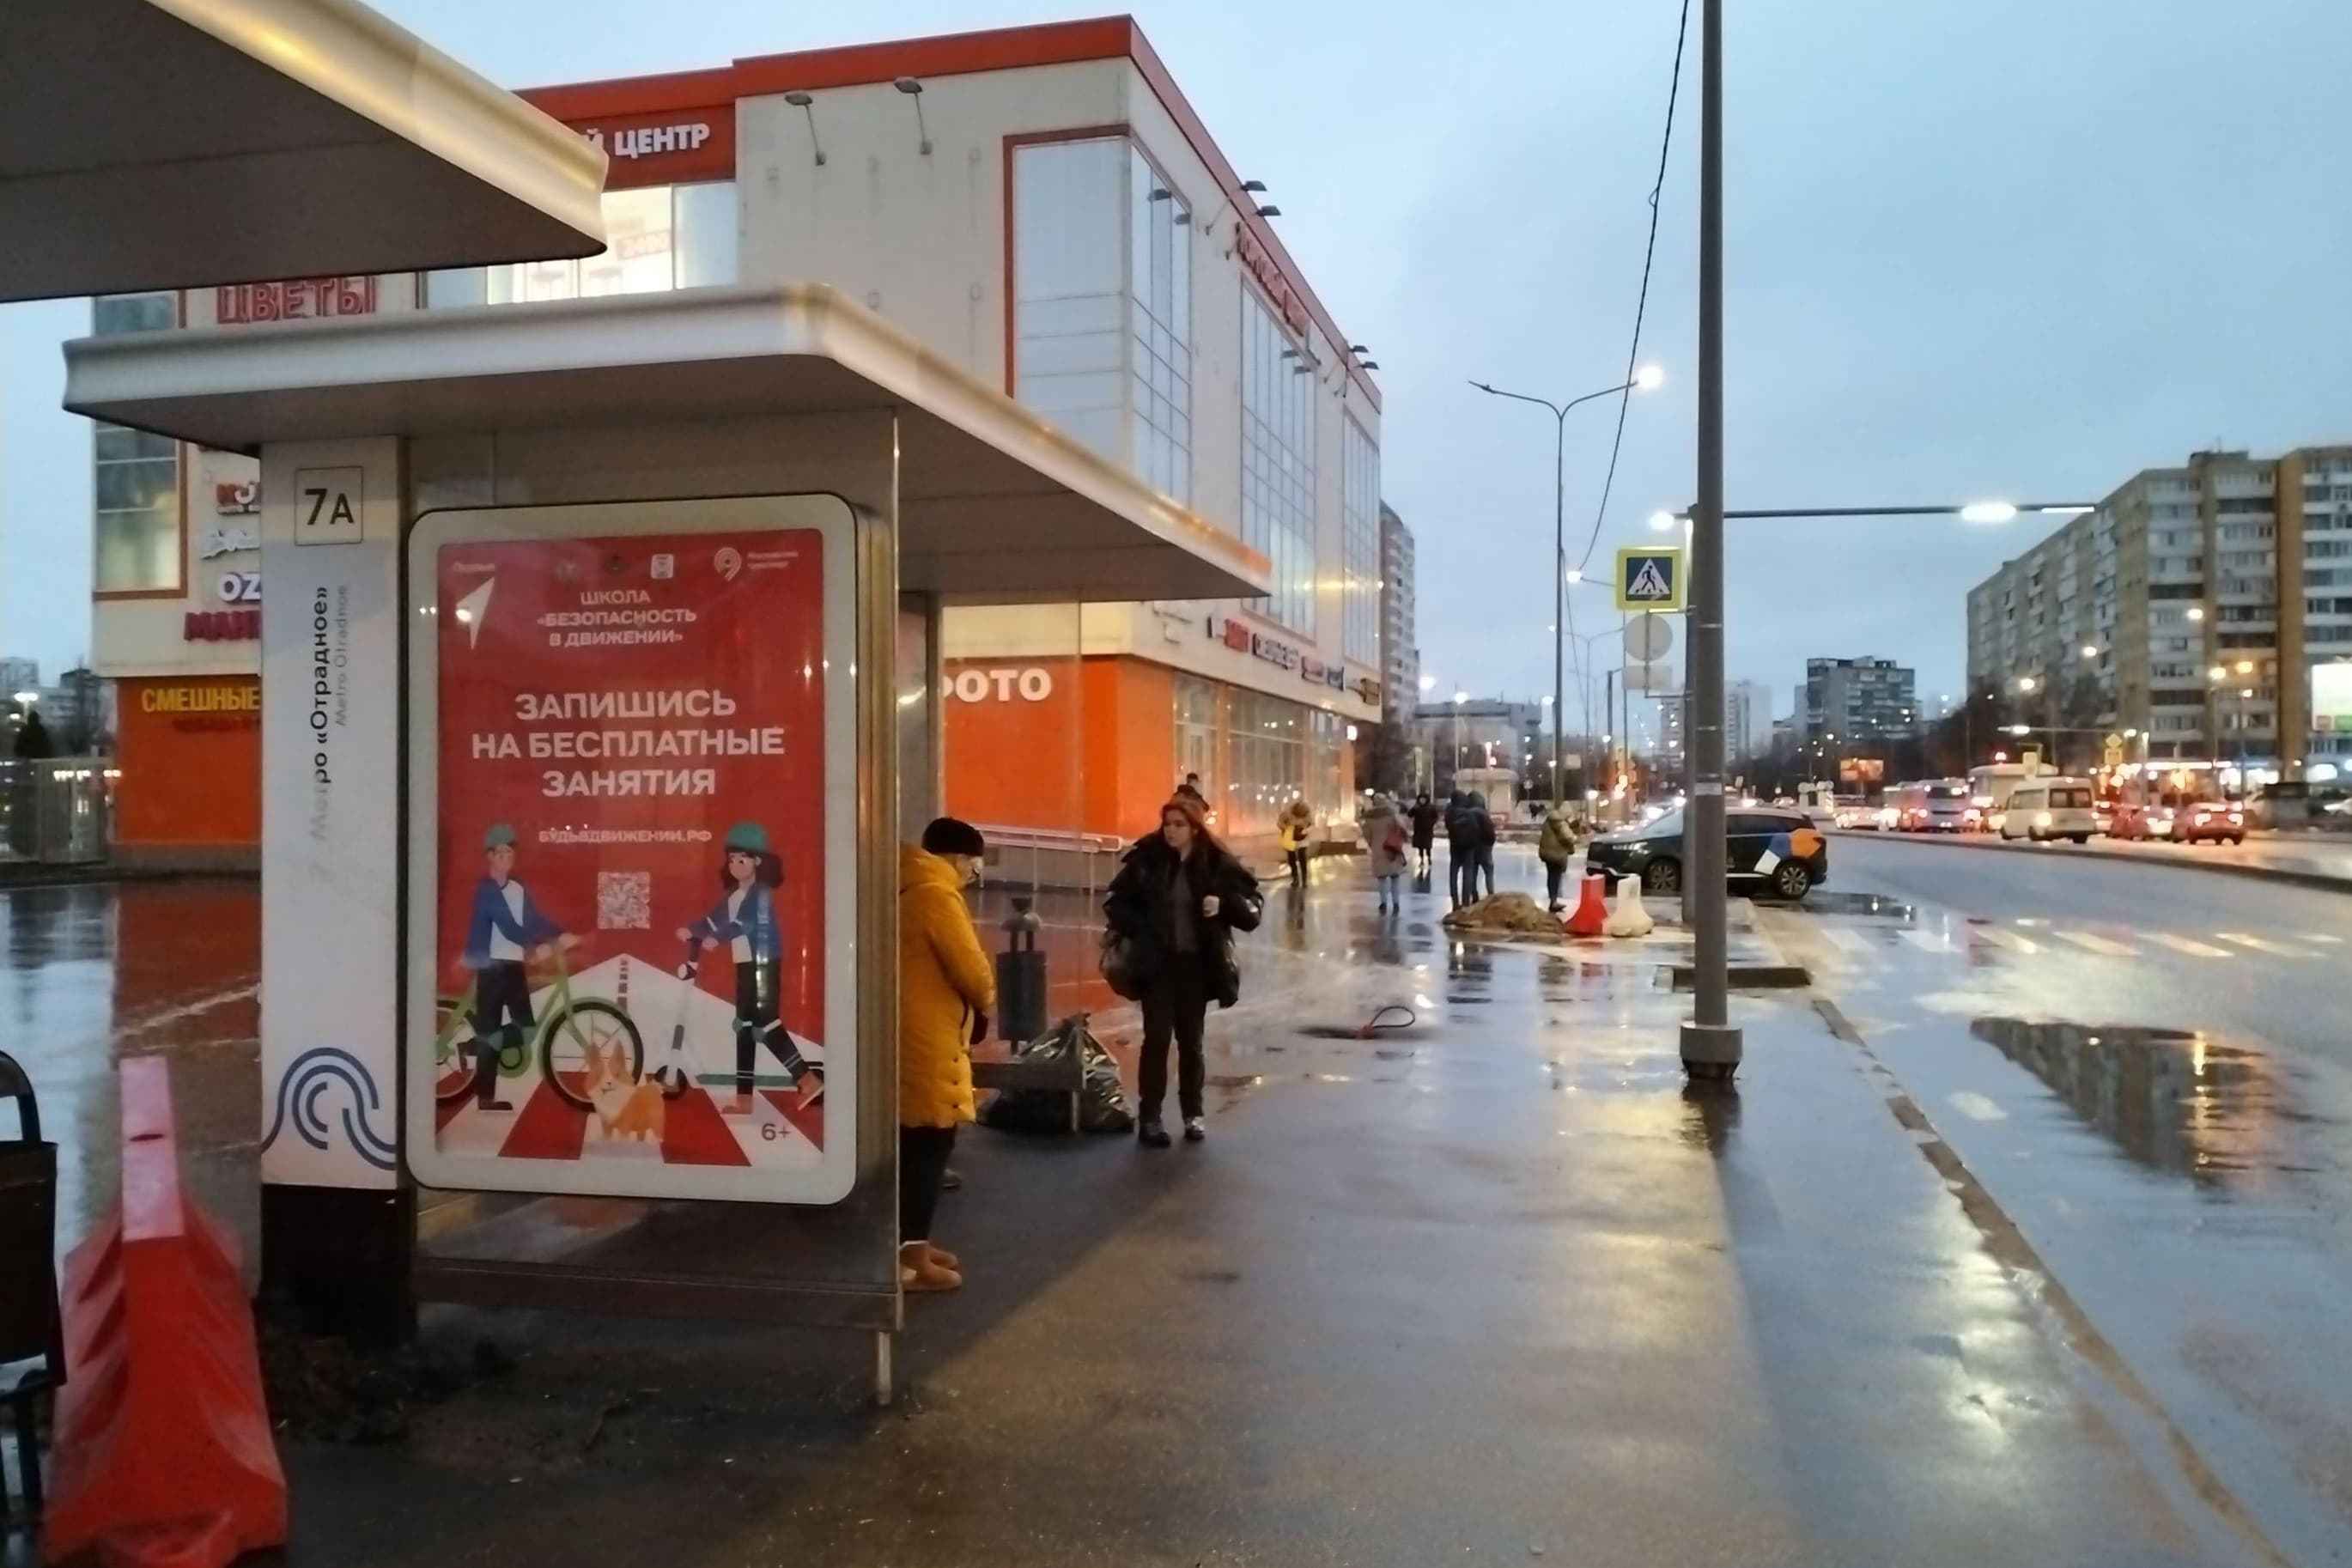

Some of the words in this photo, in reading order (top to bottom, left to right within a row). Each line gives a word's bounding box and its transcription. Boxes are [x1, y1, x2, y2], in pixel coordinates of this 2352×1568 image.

[614, 123, 710, 159] ЦЕНТР
[217, 274, 377, 324] ЦВЕТЫ
[580, 590, 651, 605] ШКОЛА
[334, 585, 349, 668] Otradnoe
[537, 608, 697, 627] «БЕЗОПАСНОСТЬ
[549, 632, 562, 647] В
[564, 629, 684, 647] ДВИЖЕНИИ»
[310, 586, 331, 744] «Отрадное»
[142, 687, 261, 713] СМЕШНЫЕ
[334, 673, 348, 727] Metro
[515, 690, 736, 720] ЗАПИШИСЬ
[471, 732, 520, 758] НА
[528, 727, 785, 758] БЕСПЛАТНЫЕ
[542, 769, 715, 797] ЗАНЯТИЯ
[762, 1122, 791, 1141] 6+
